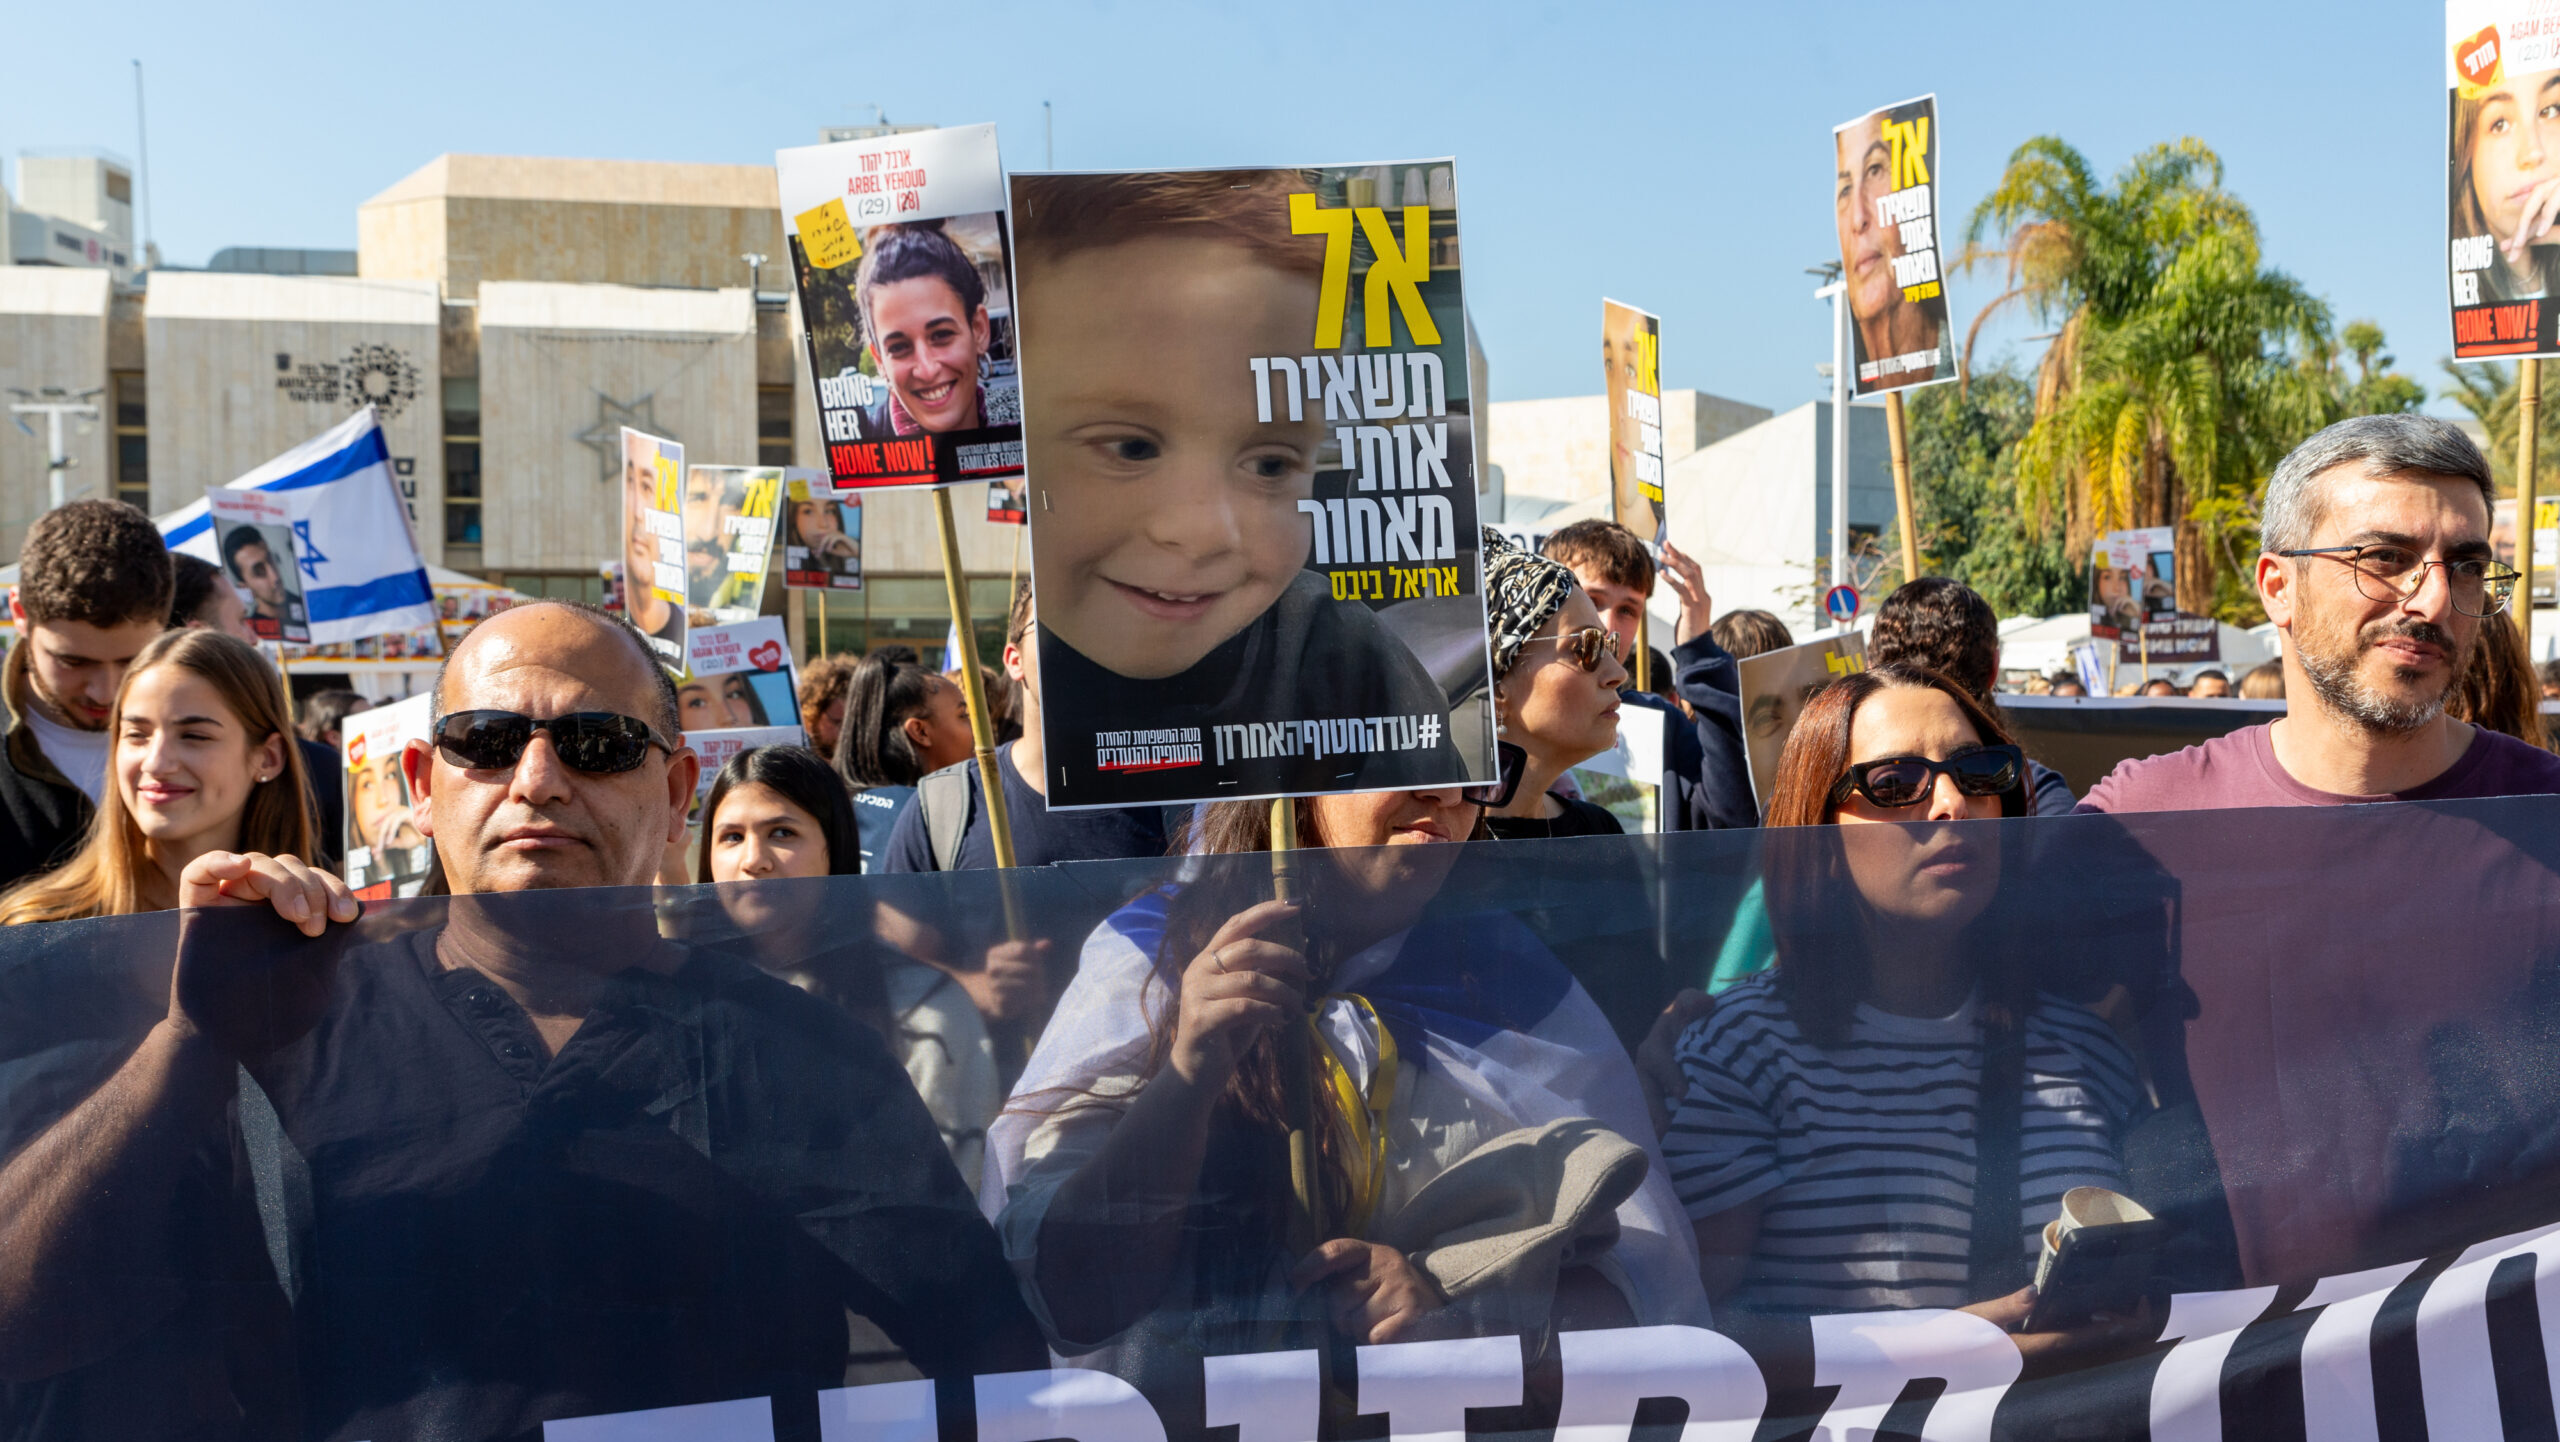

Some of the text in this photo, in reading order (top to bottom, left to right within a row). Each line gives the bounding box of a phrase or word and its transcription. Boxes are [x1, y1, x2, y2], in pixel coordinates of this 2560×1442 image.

[859, 149, 911, 172] ארבל יהוד
[1881, 116, 1930, 192] אל
[848, 168, 926, 195] ARBEL YEHOUD
[858, 196, 891, 218] (29)
[1288, 192, 1442, 349] אל
[2452, 234, 2494, 272] BRING
[2452, 271, 2480, 307] HER
[2455, 299, 2539, 344] HOME NOW!
[1633, 321, 1659, 398] אל
[820, 376, 874, 409] BRING
[1250, 352, 1446, 424] תשאירו
[824, 409, 862, 442] HER
[830, 435, 936, 476] HOME NOW!
[958, 450, 1024, 471] FAMILIES FORU
[1335, 422, 1452, 491] אותי
[1297, 495, 1456, 565] מאחור
[1331, 566, 1460, 602] אריאל ביבס
[1096, 727, 1201, 747] מטה המשפחות להחזרת
[1097, 743, 1203, 767] החטופים והנעדרים
